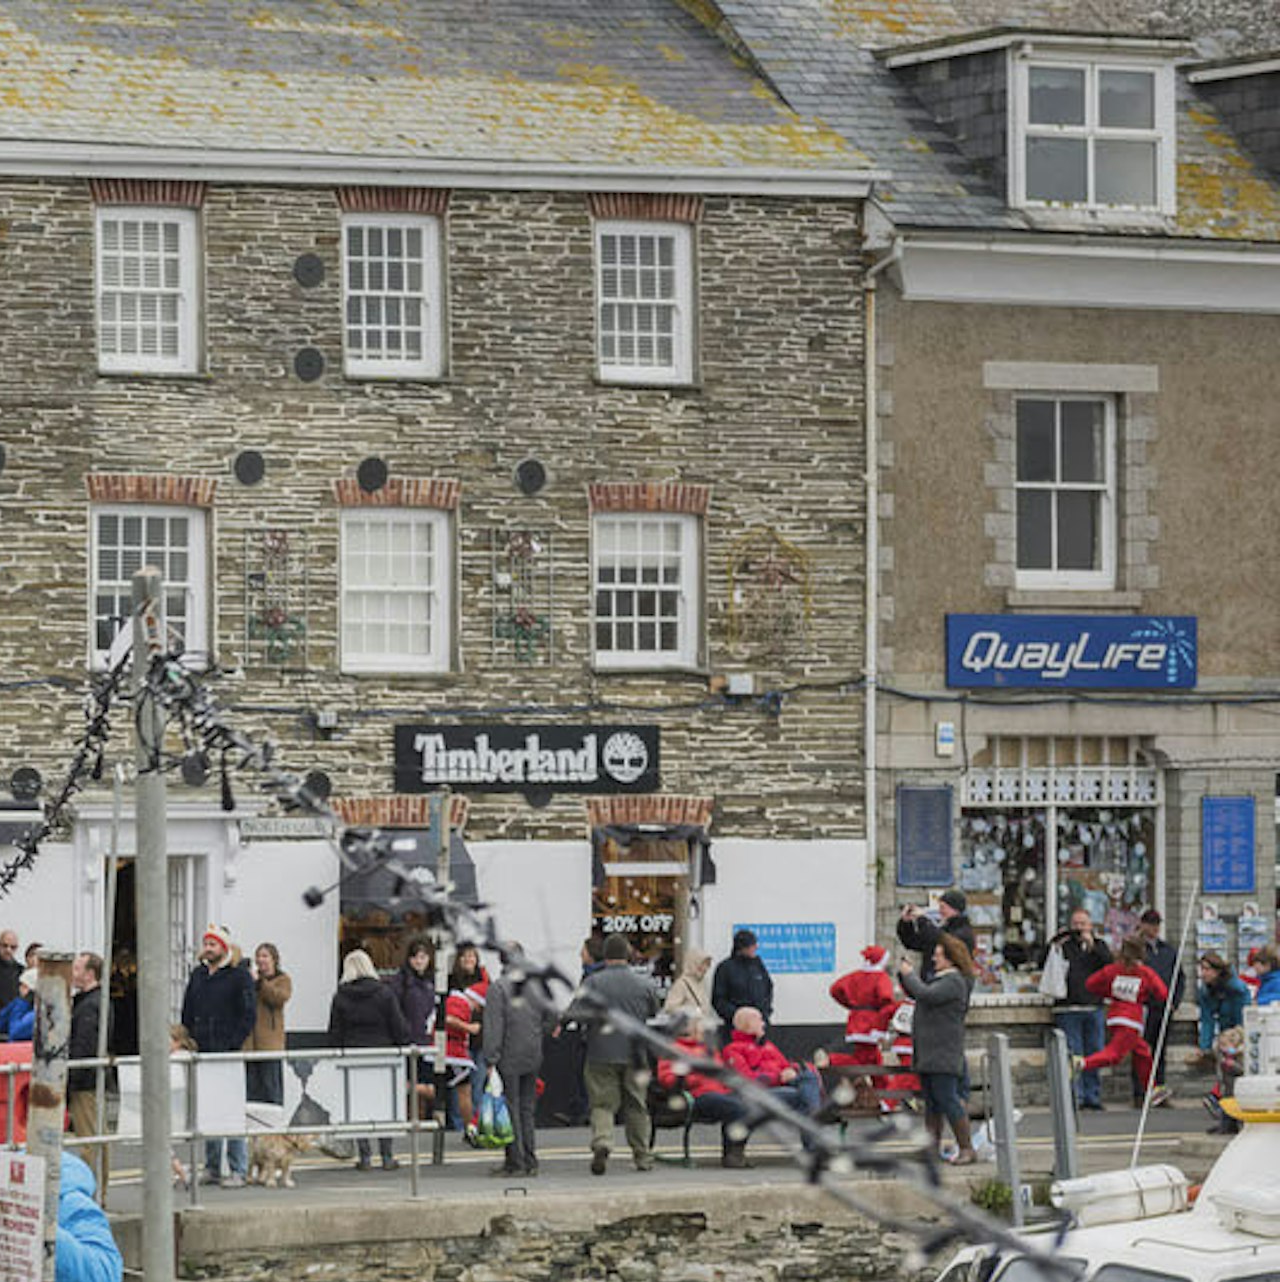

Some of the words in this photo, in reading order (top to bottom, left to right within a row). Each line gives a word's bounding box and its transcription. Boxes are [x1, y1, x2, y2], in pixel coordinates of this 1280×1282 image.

[413, 733, 599, 784] Timberland
[602, 915, 639, 933] 20%
[640, 913, 674, 933] OFF
